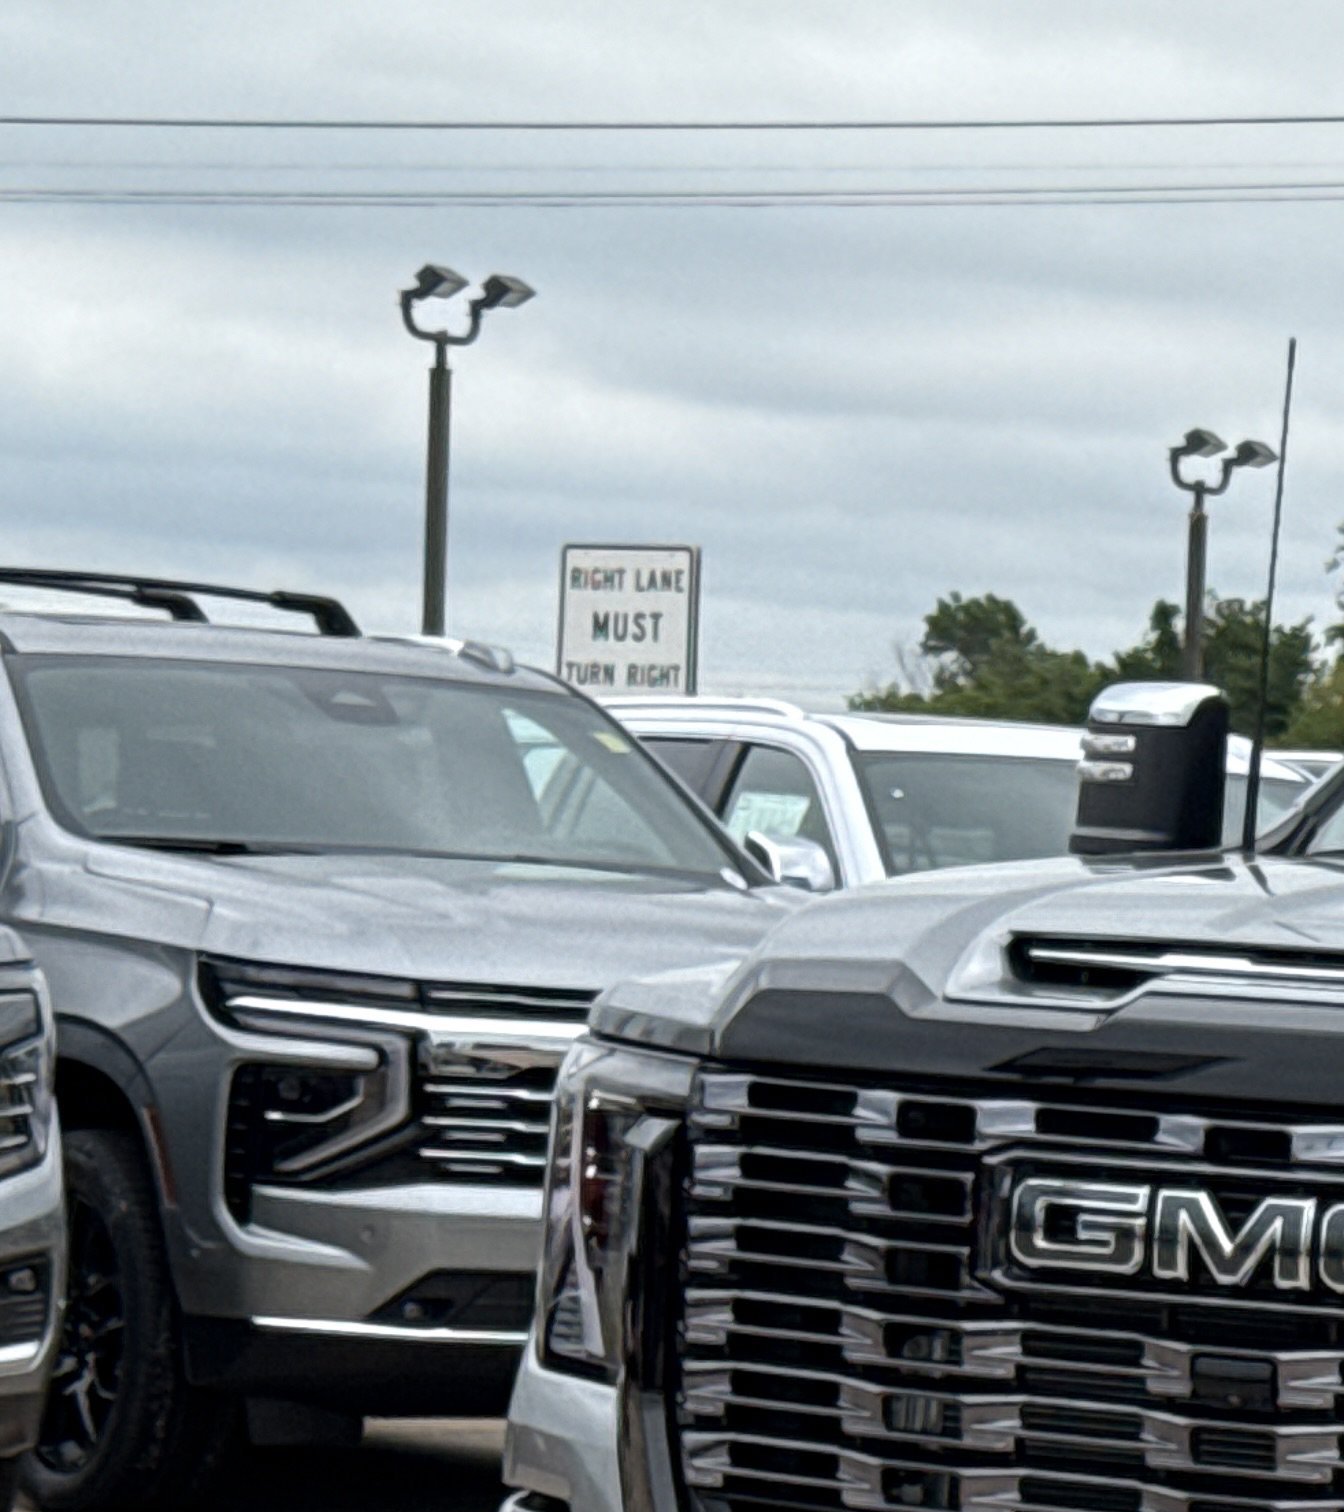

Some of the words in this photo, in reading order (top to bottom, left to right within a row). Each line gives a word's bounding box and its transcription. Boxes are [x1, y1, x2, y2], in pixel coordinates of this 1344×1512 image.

[570, 566, 626, 591] RIGHT
[634, 568, 685, 593] LANE
[591, 611, 663, 642] MUST
[565, 661, 616, 686] TURN
[627, 663, 681, 688] RIGHT
